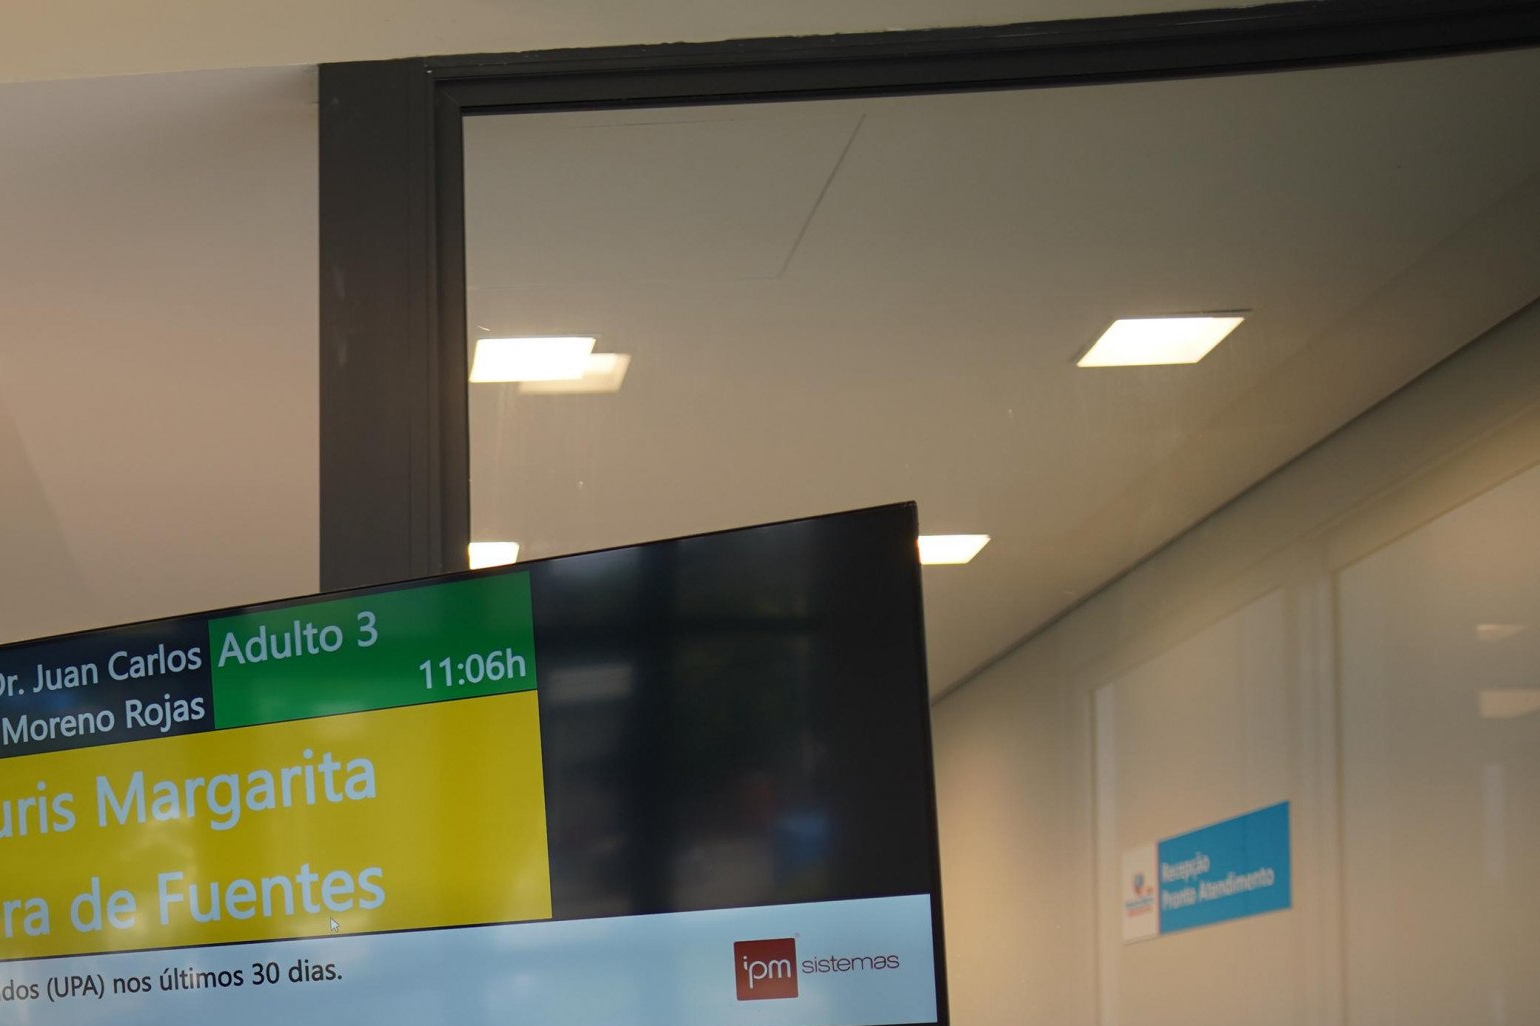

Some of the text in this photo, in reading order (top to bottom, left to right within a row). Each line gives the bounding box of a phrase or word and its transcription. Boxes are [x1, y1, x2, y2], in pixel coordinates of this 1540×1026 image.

[218, 611, 379, 667] Adulto 3
[32, 663, 98, 694] Juan
[107, 643, 202, 681] Carlos
[418, 648, 527, 691] 11:06h
[1, 694, 206, 746] Moreno Rojas
[98, 748, 377, 832] Margarita
[70, 876, 137, 931] de
[159, 863, 386, 925] Fuentes
[47, 974, 106, 1003] (UPA)
[113, 973, 152, 995] nos
[160, 966, 244, 992] últimos
[251, 962, 280, 986] 30
[287, 959, 343, 983] dias.
[742, 955, 899, 989] ipm sistemas
